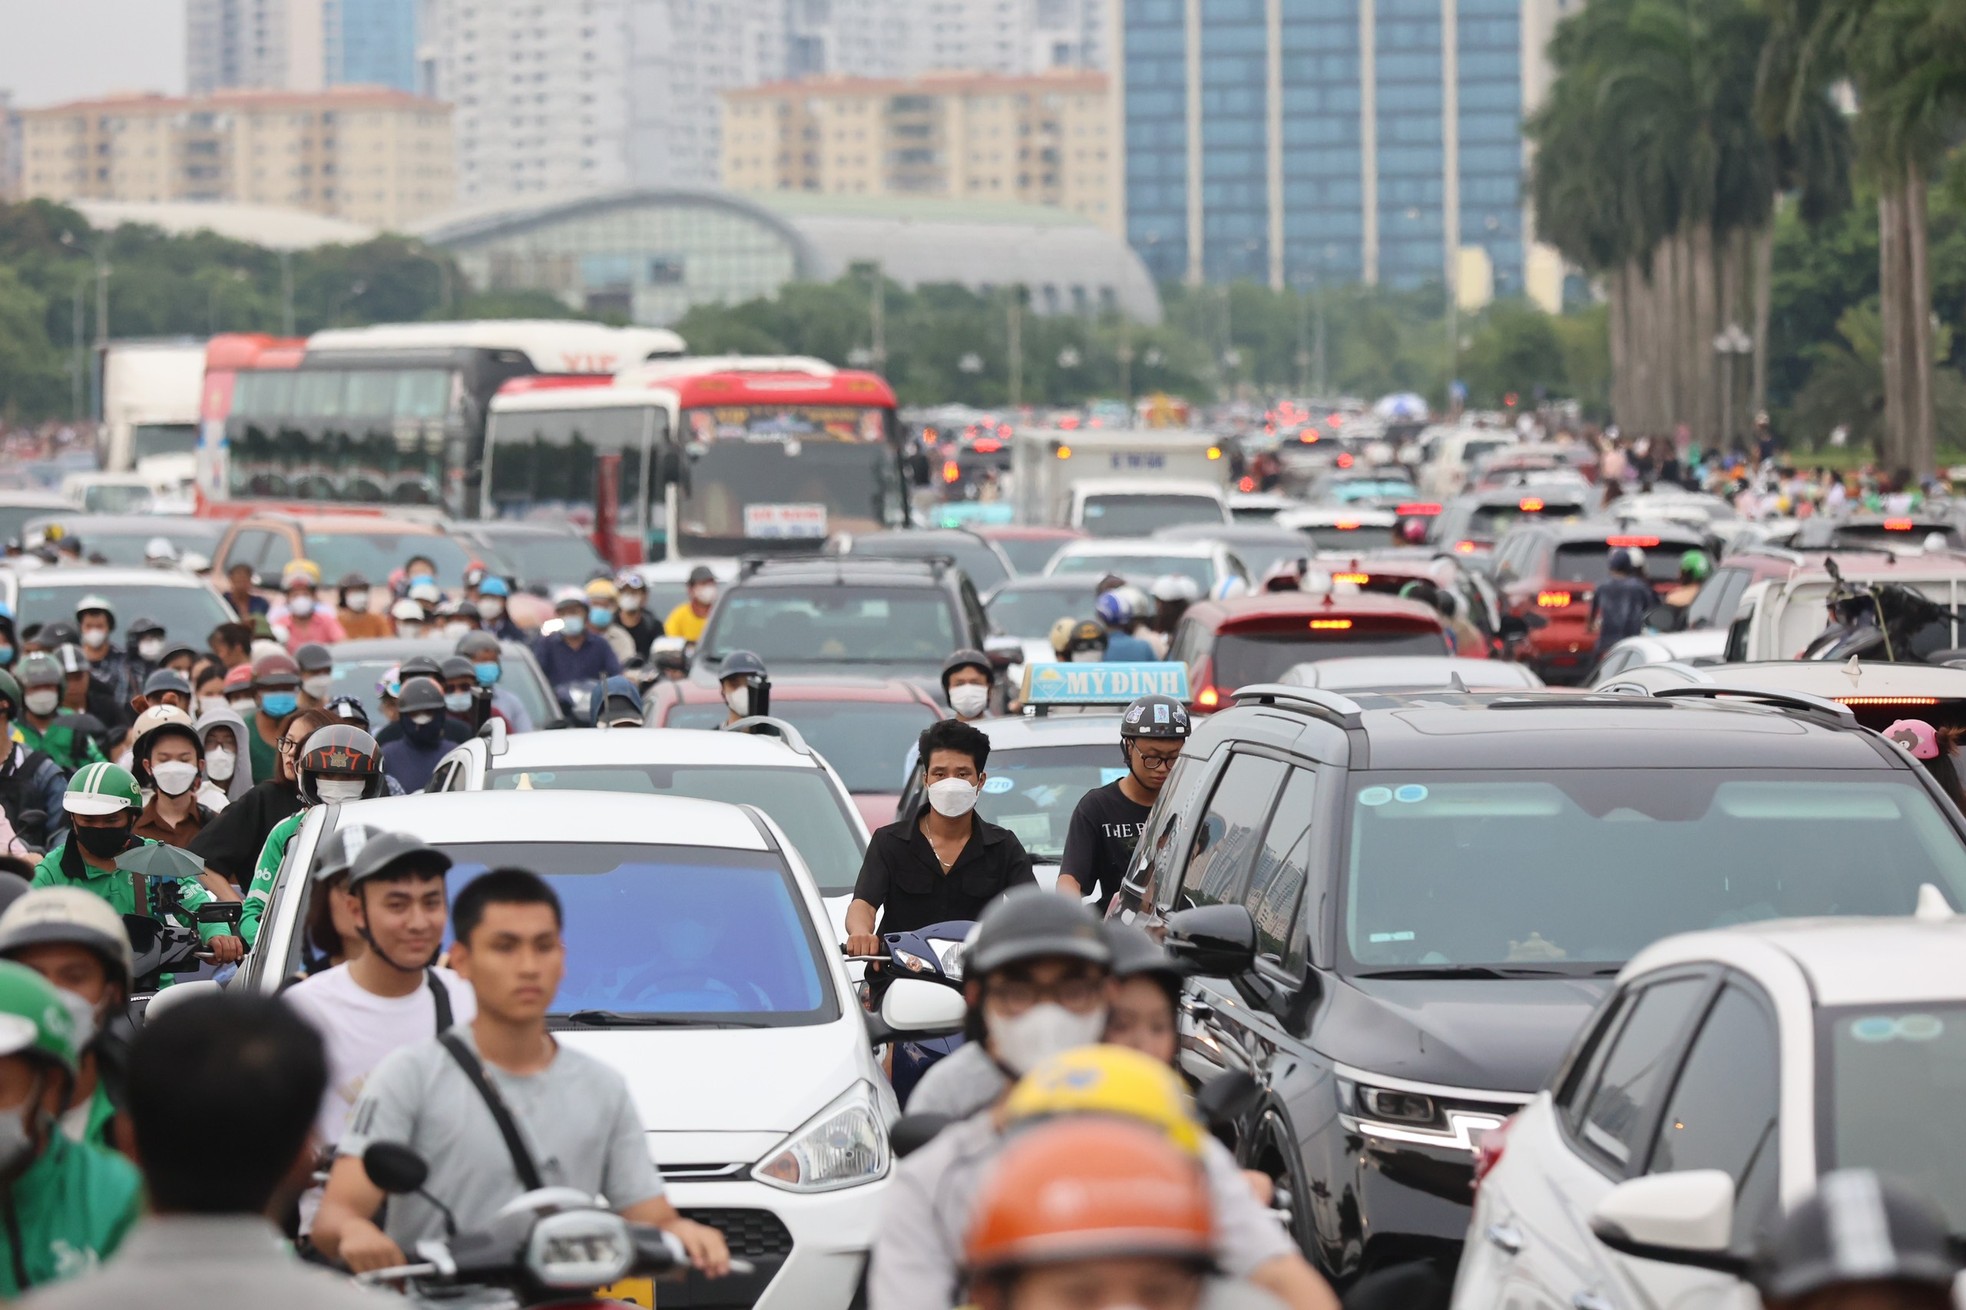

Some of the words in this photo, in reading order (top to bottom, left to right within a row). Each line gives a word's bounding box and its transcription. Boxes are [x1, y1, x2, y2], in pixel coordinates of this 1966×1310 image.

[1067, 668, 1108, 695] MỸ
[1111, 668, 1179, 695] ĐÌNH
[1102, 823, 1133, 838] THE
